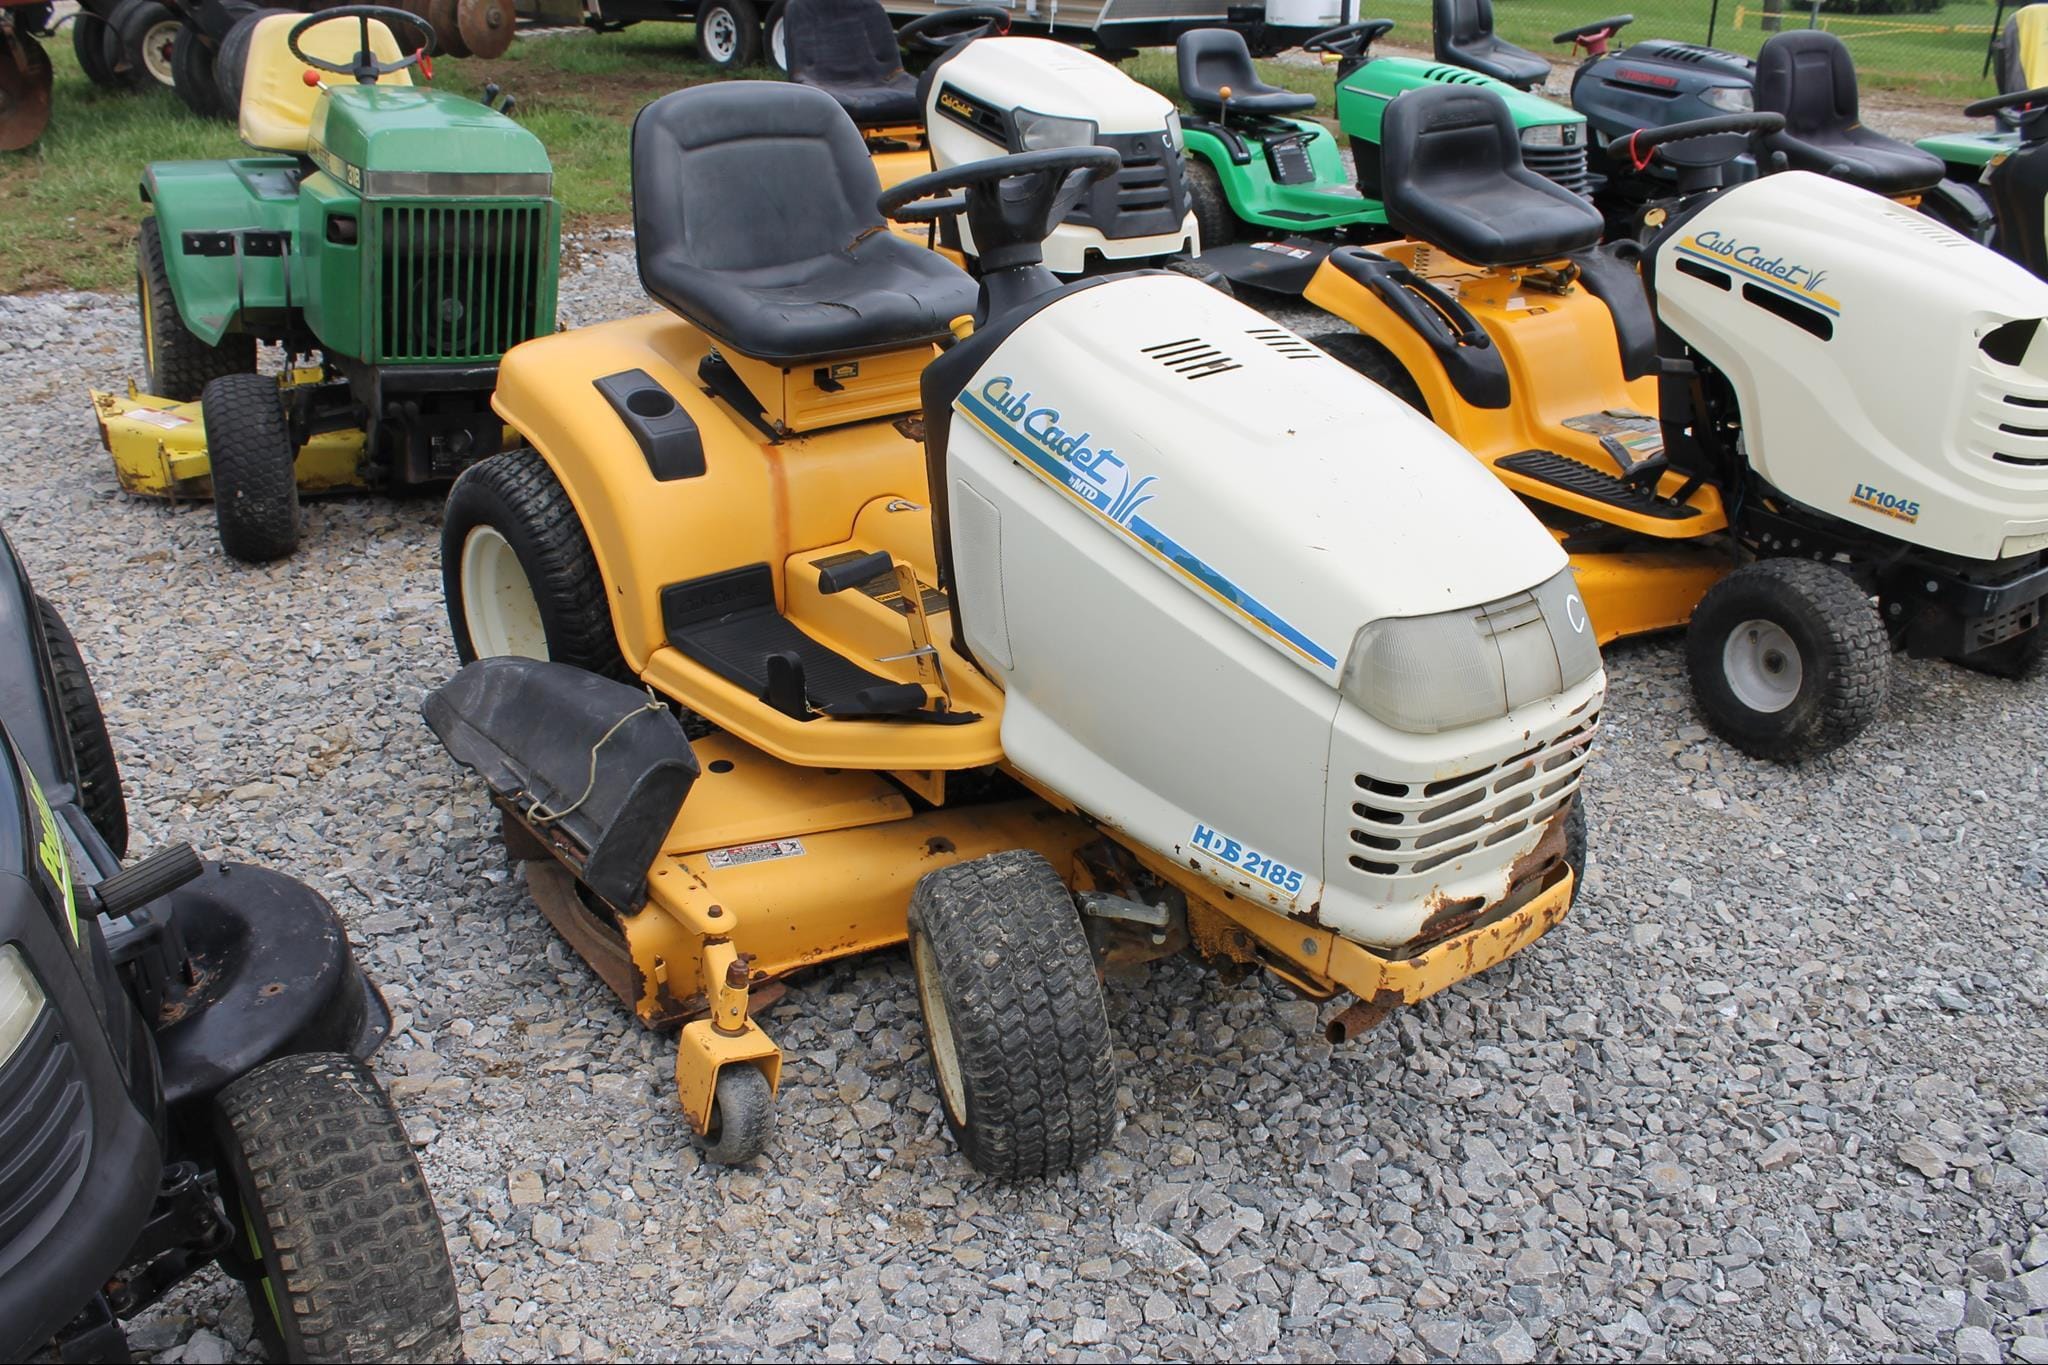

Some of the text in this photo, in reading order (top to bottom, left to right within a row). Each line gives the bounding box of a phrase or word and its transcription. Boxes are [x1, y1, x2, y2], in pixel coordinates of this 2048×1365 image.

[347, 164, 361, 189] 318
[1695, 231, 1809, 285] Cub Cadet
[982, 376, 1125, 485] Cub Cadet
[1072, 478, 1098, 500] MTD
[1855, 483, 1920, 516] LT1045
[1192, 824, 1303, 892] HDS 2185
